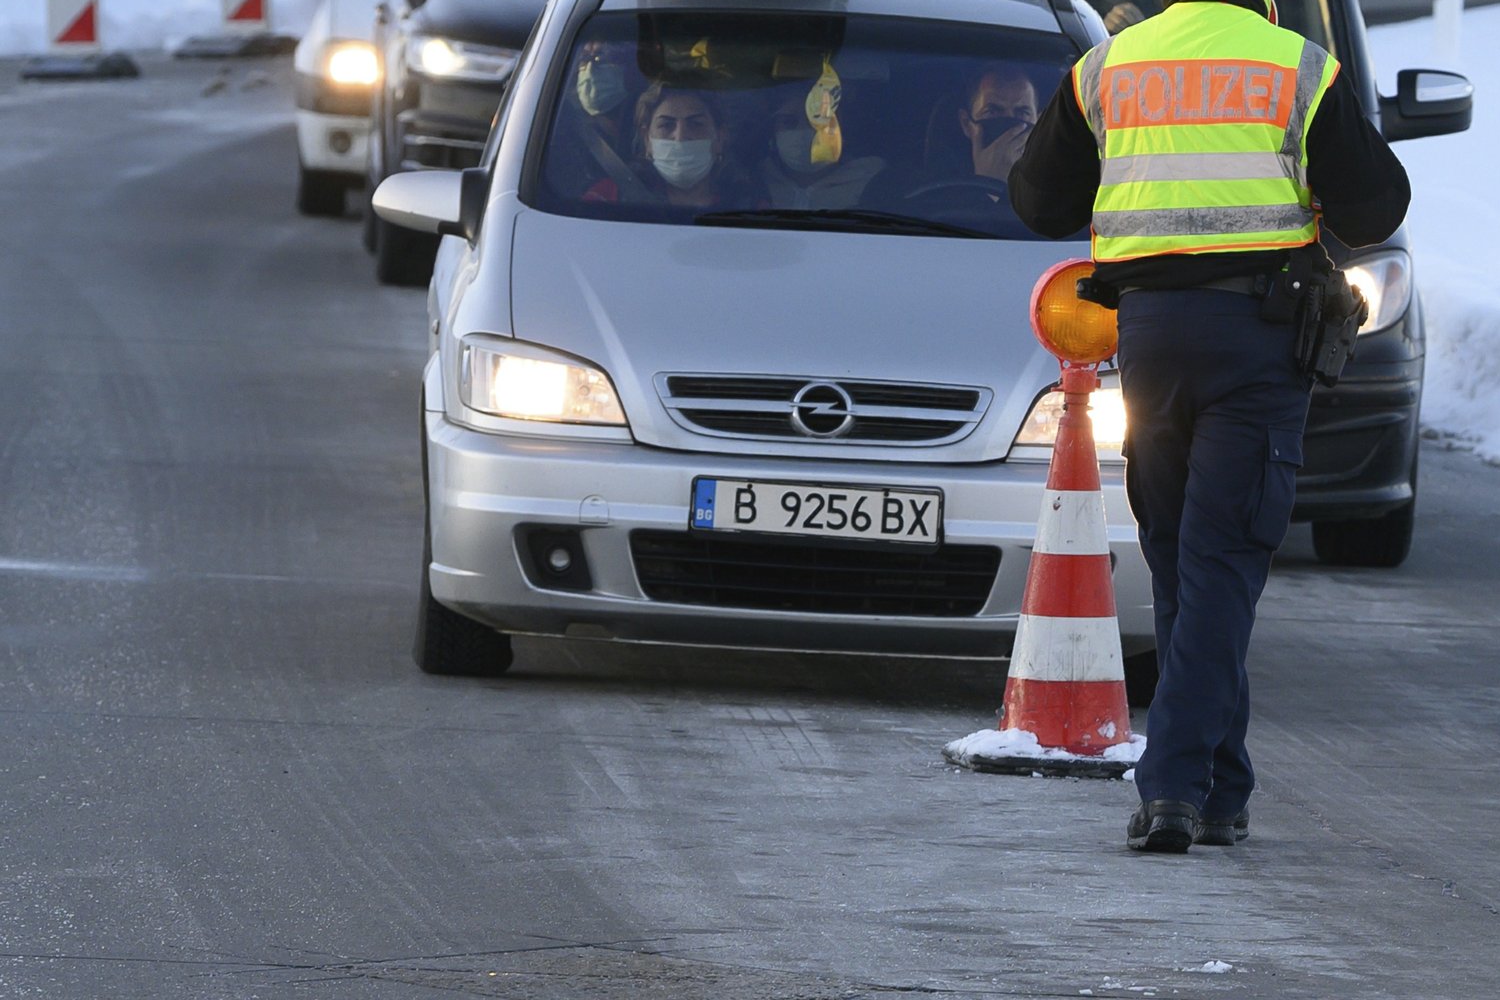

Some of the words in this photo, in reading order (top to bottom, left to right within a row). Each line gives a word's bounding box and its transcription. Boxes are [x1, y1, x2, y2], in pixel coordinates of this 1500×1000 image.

[1110, 64, 1285, 124] POLIZEI
[696, 508, 713, 521] BG
[734, 486, 757, 525] B
[780, 491, 872, 532] 9256
